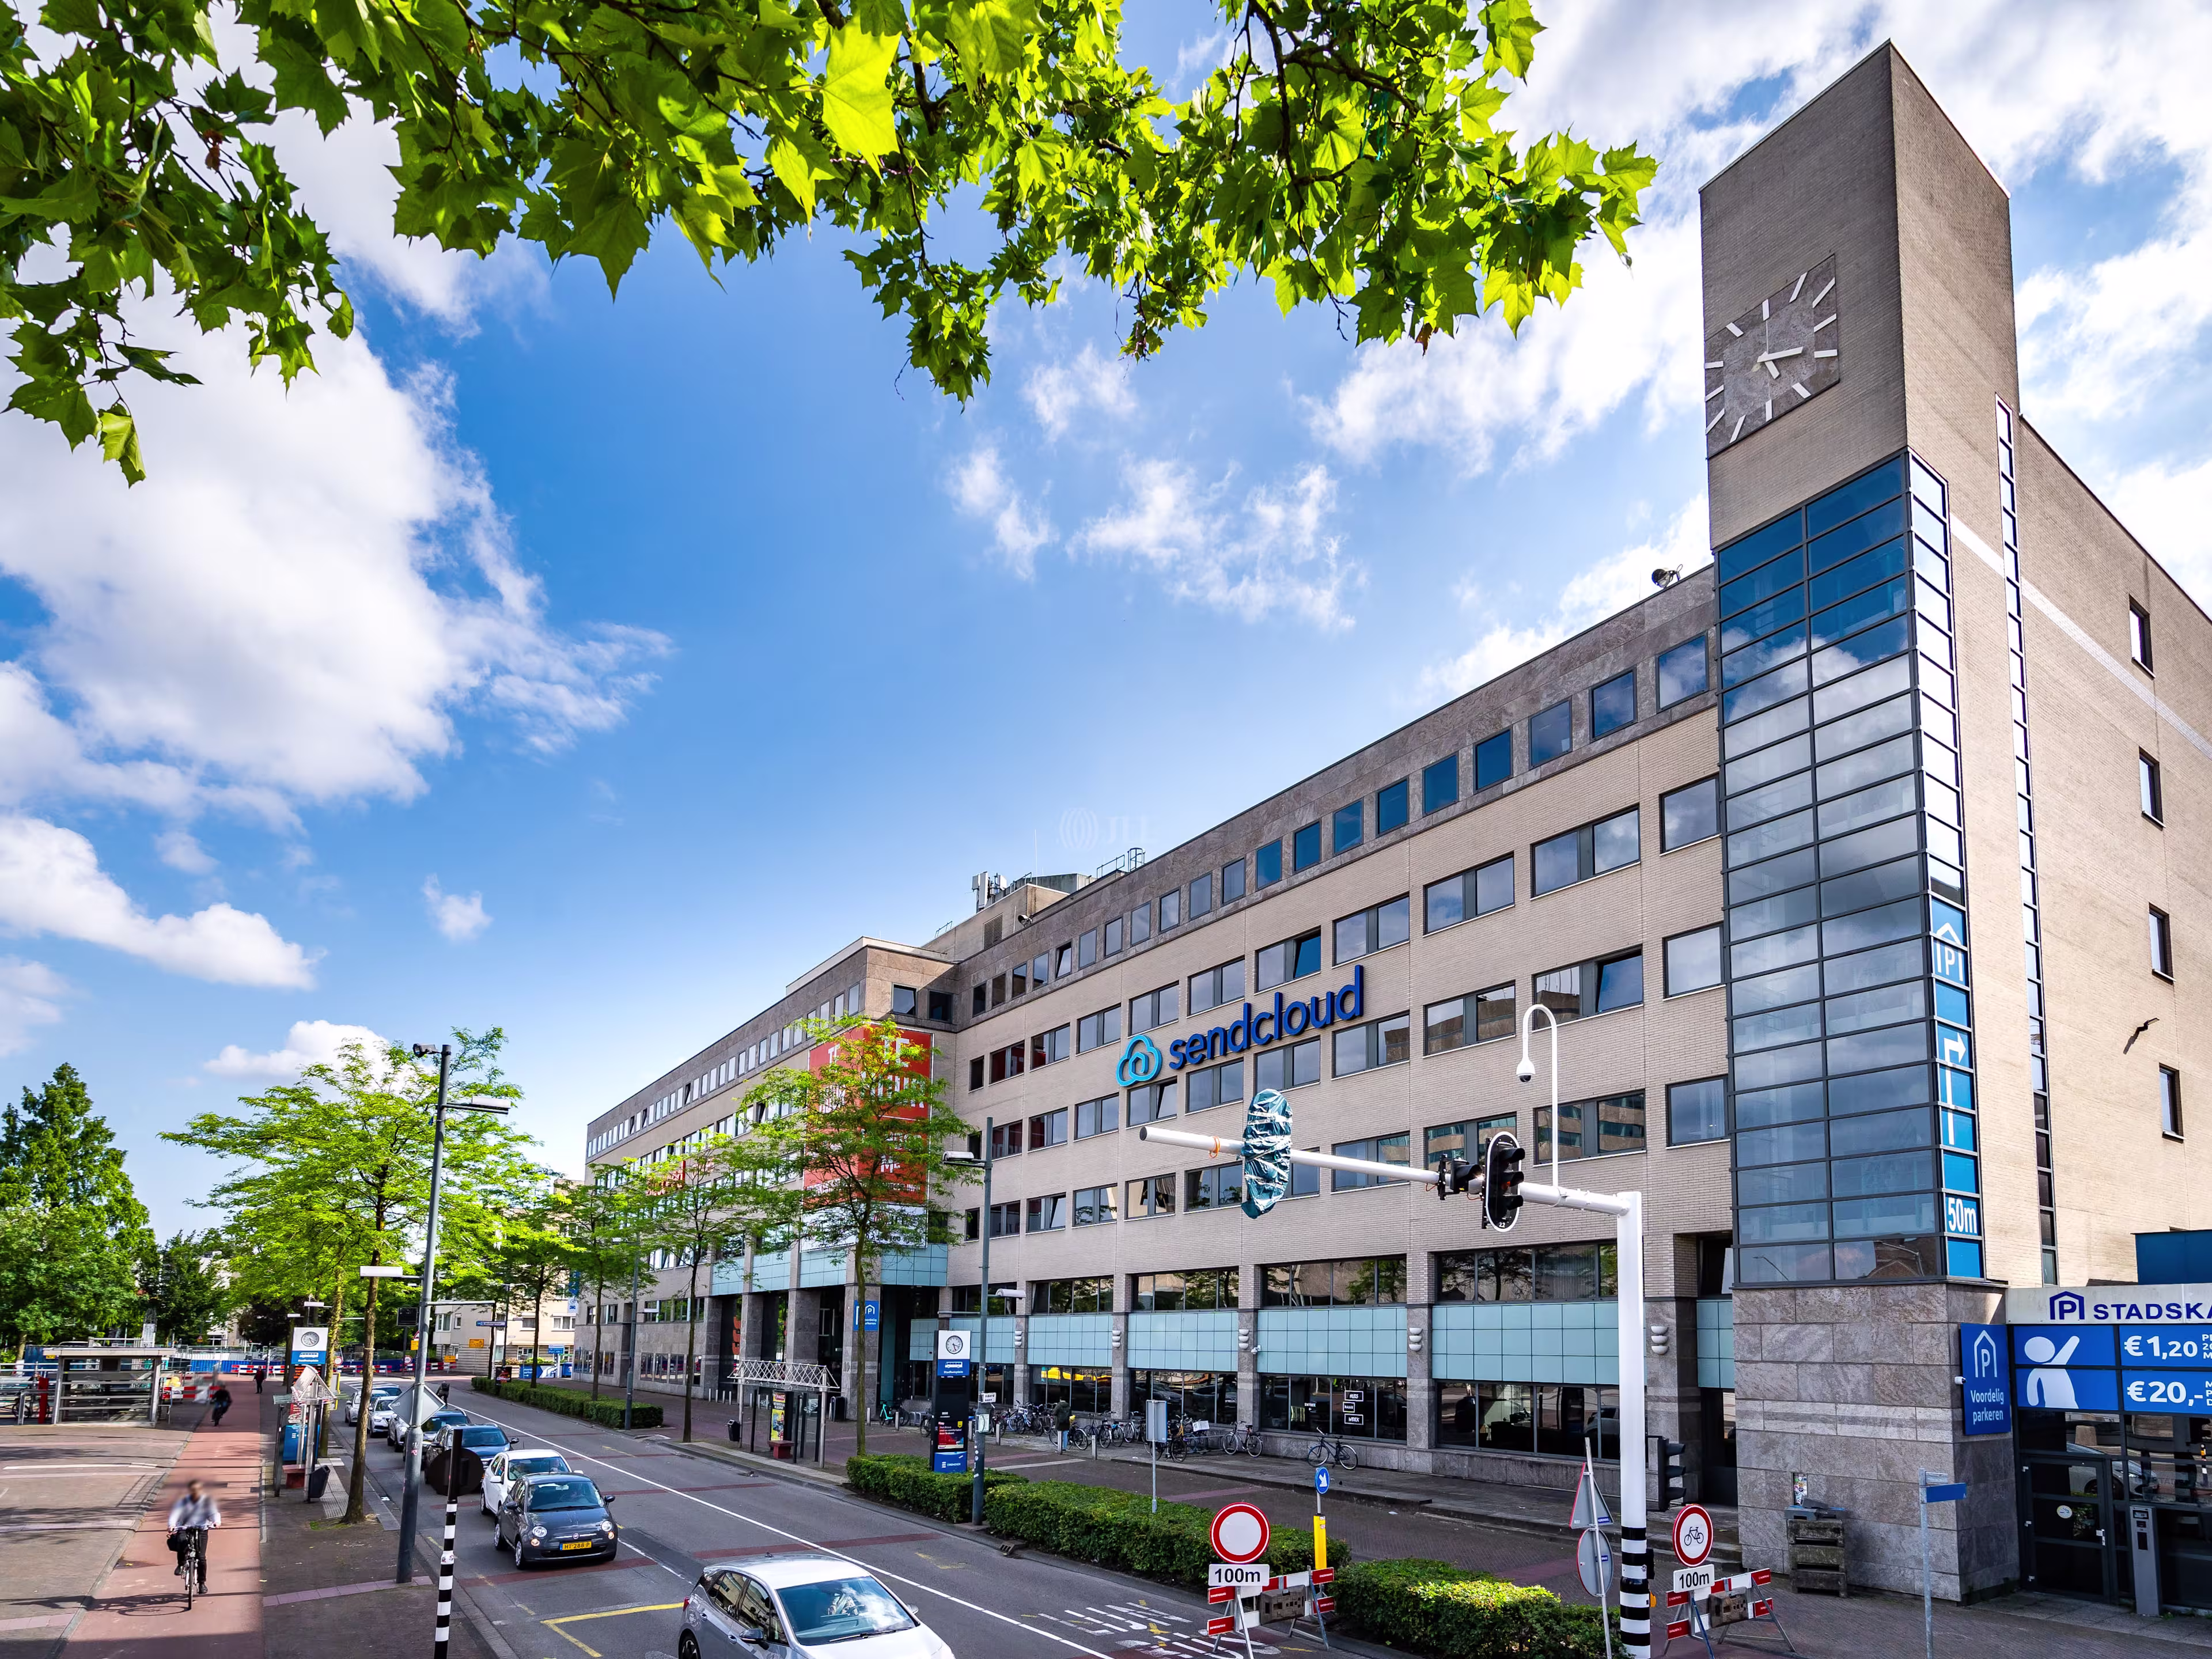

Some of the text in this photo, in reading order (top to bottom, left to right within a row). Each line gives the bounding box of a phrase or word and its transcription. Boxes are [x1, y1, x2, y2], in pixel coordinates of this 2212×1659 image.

[1169, 964, 1364, 1070] sendcloud
[1948, 1197, 1978, 1234] 50m
[1970, 1388, 2005, 1405] Voordelig
[1972, 1407, 2004, 1425] parkeren
[1214, 1568, 1261, 1584] 100m
[1679, 1571, 1710, 1589] 100m
